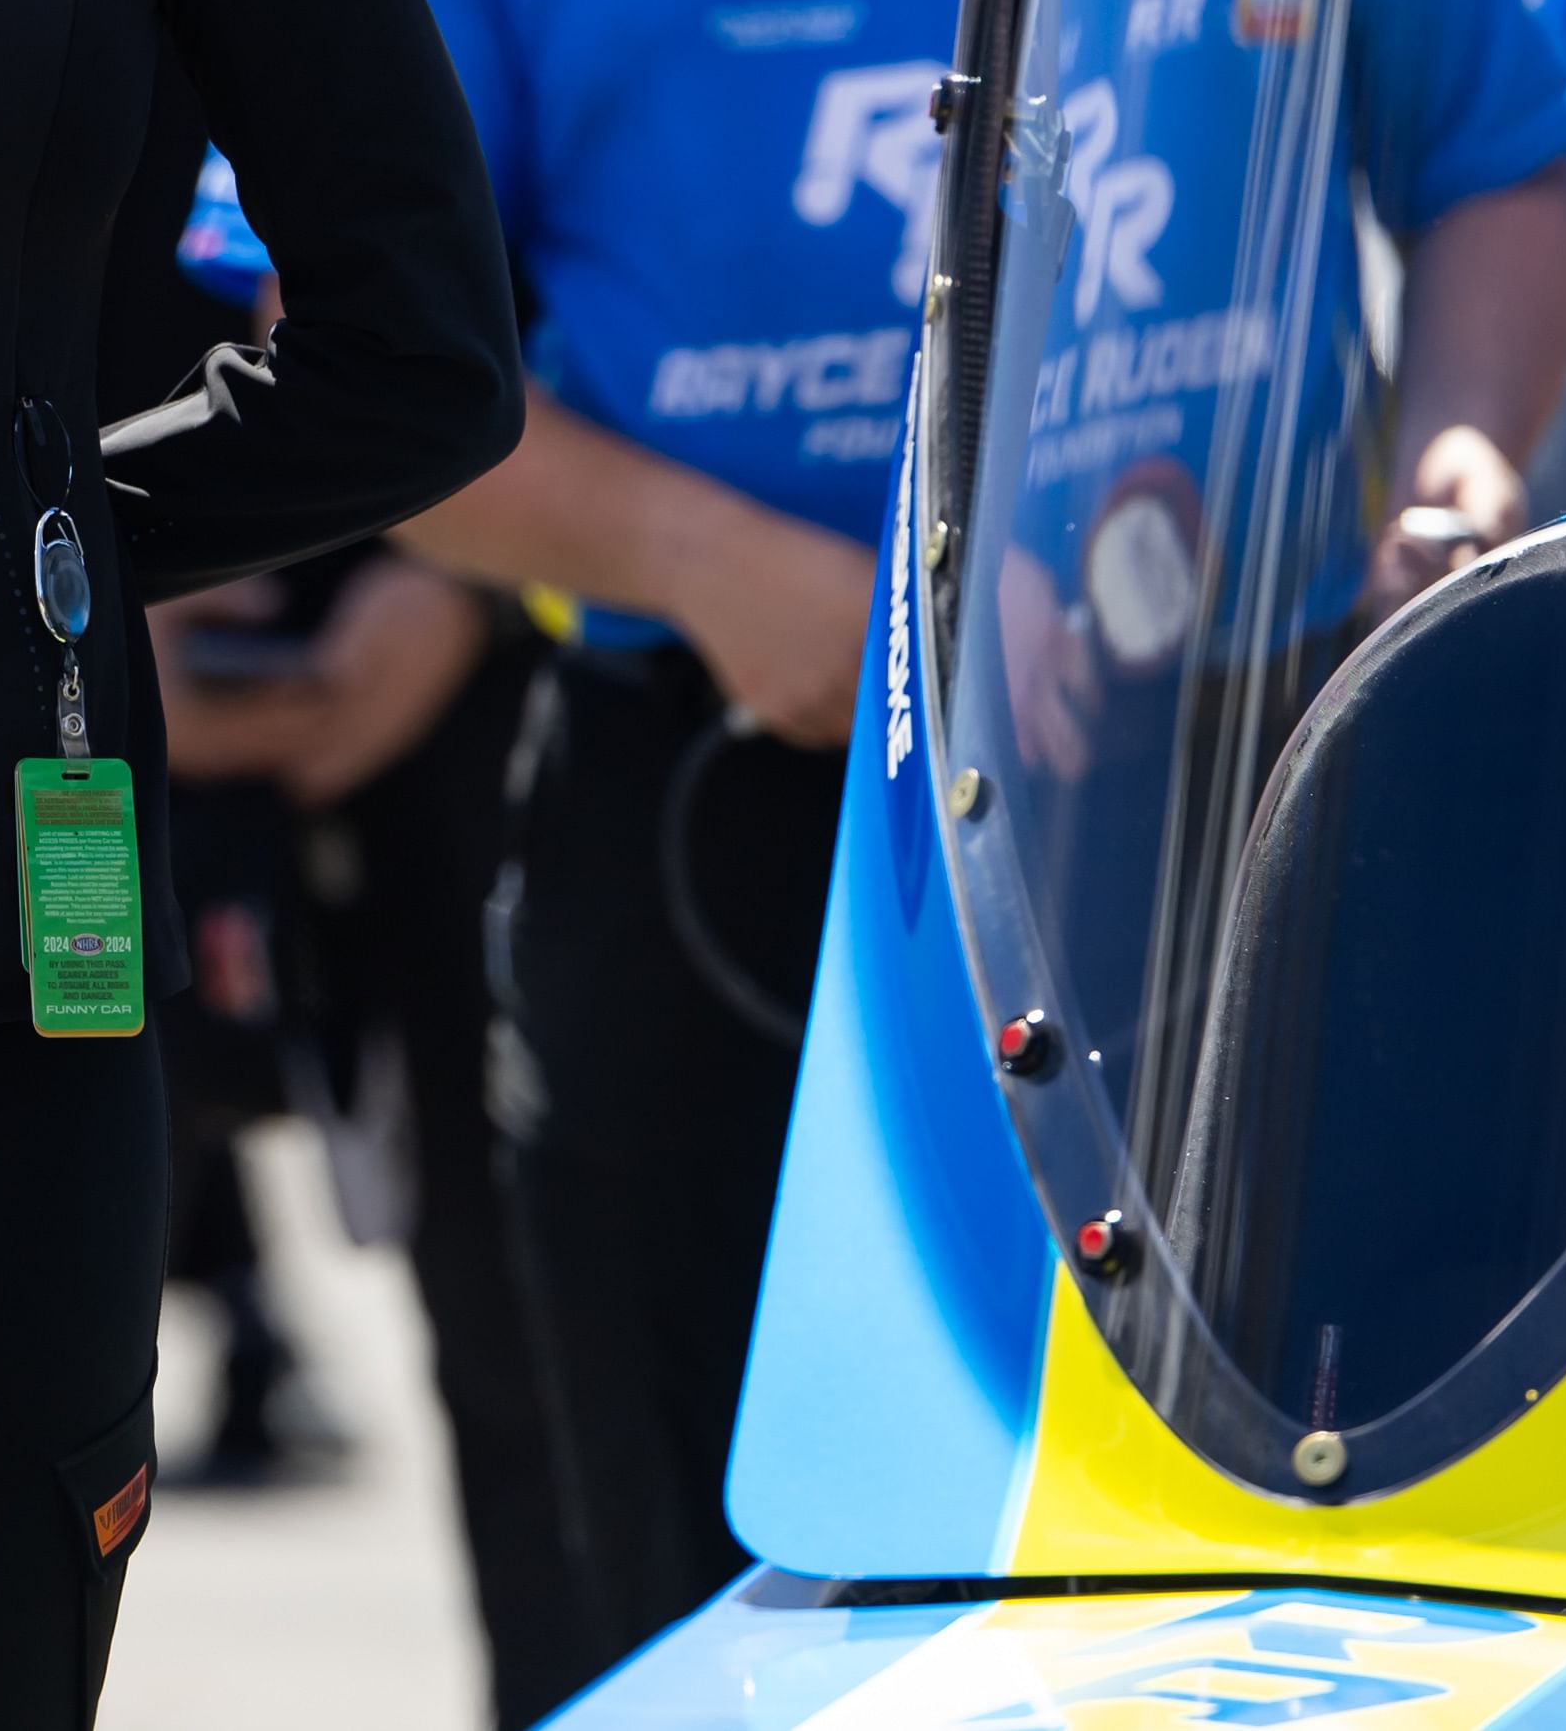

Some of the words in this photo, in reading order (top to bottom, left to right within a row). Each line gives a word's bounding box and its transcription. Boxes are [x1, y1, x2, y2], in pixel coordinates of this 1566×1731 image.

[43, 936, 69, 952] 2024
[106, 936, 131, 952] 2024
[46, 1005, 97, 1014] FUNNY
[100, 1005, 132, 1014] CAR
